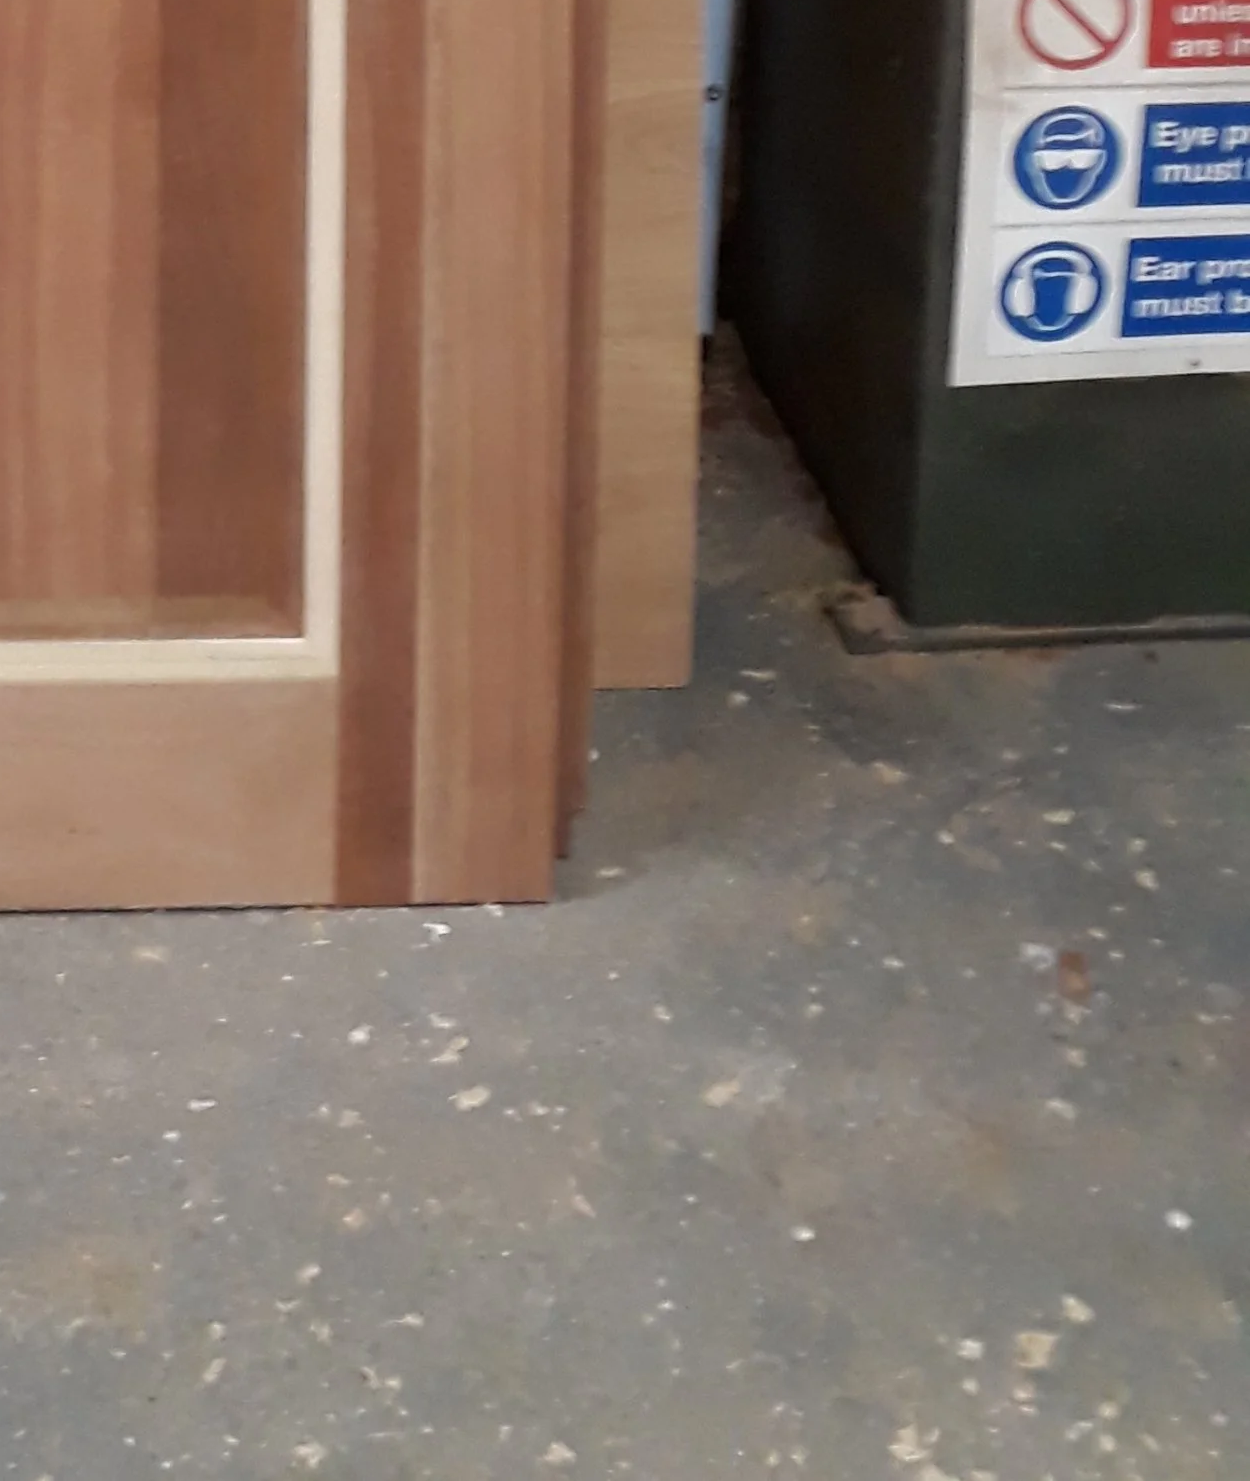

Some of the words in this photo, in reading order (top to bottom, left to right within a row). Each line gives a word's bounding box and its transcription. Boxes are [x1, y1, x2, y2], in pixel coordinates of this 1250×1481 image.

[1169, 38, 1223, 59] are
[1149, 121, 1218, 153] Eye
[1154, 156, 1243, 183] must
[1132, 256, 1196, 282] Ear
[1131, 290, 1223, 318] must
